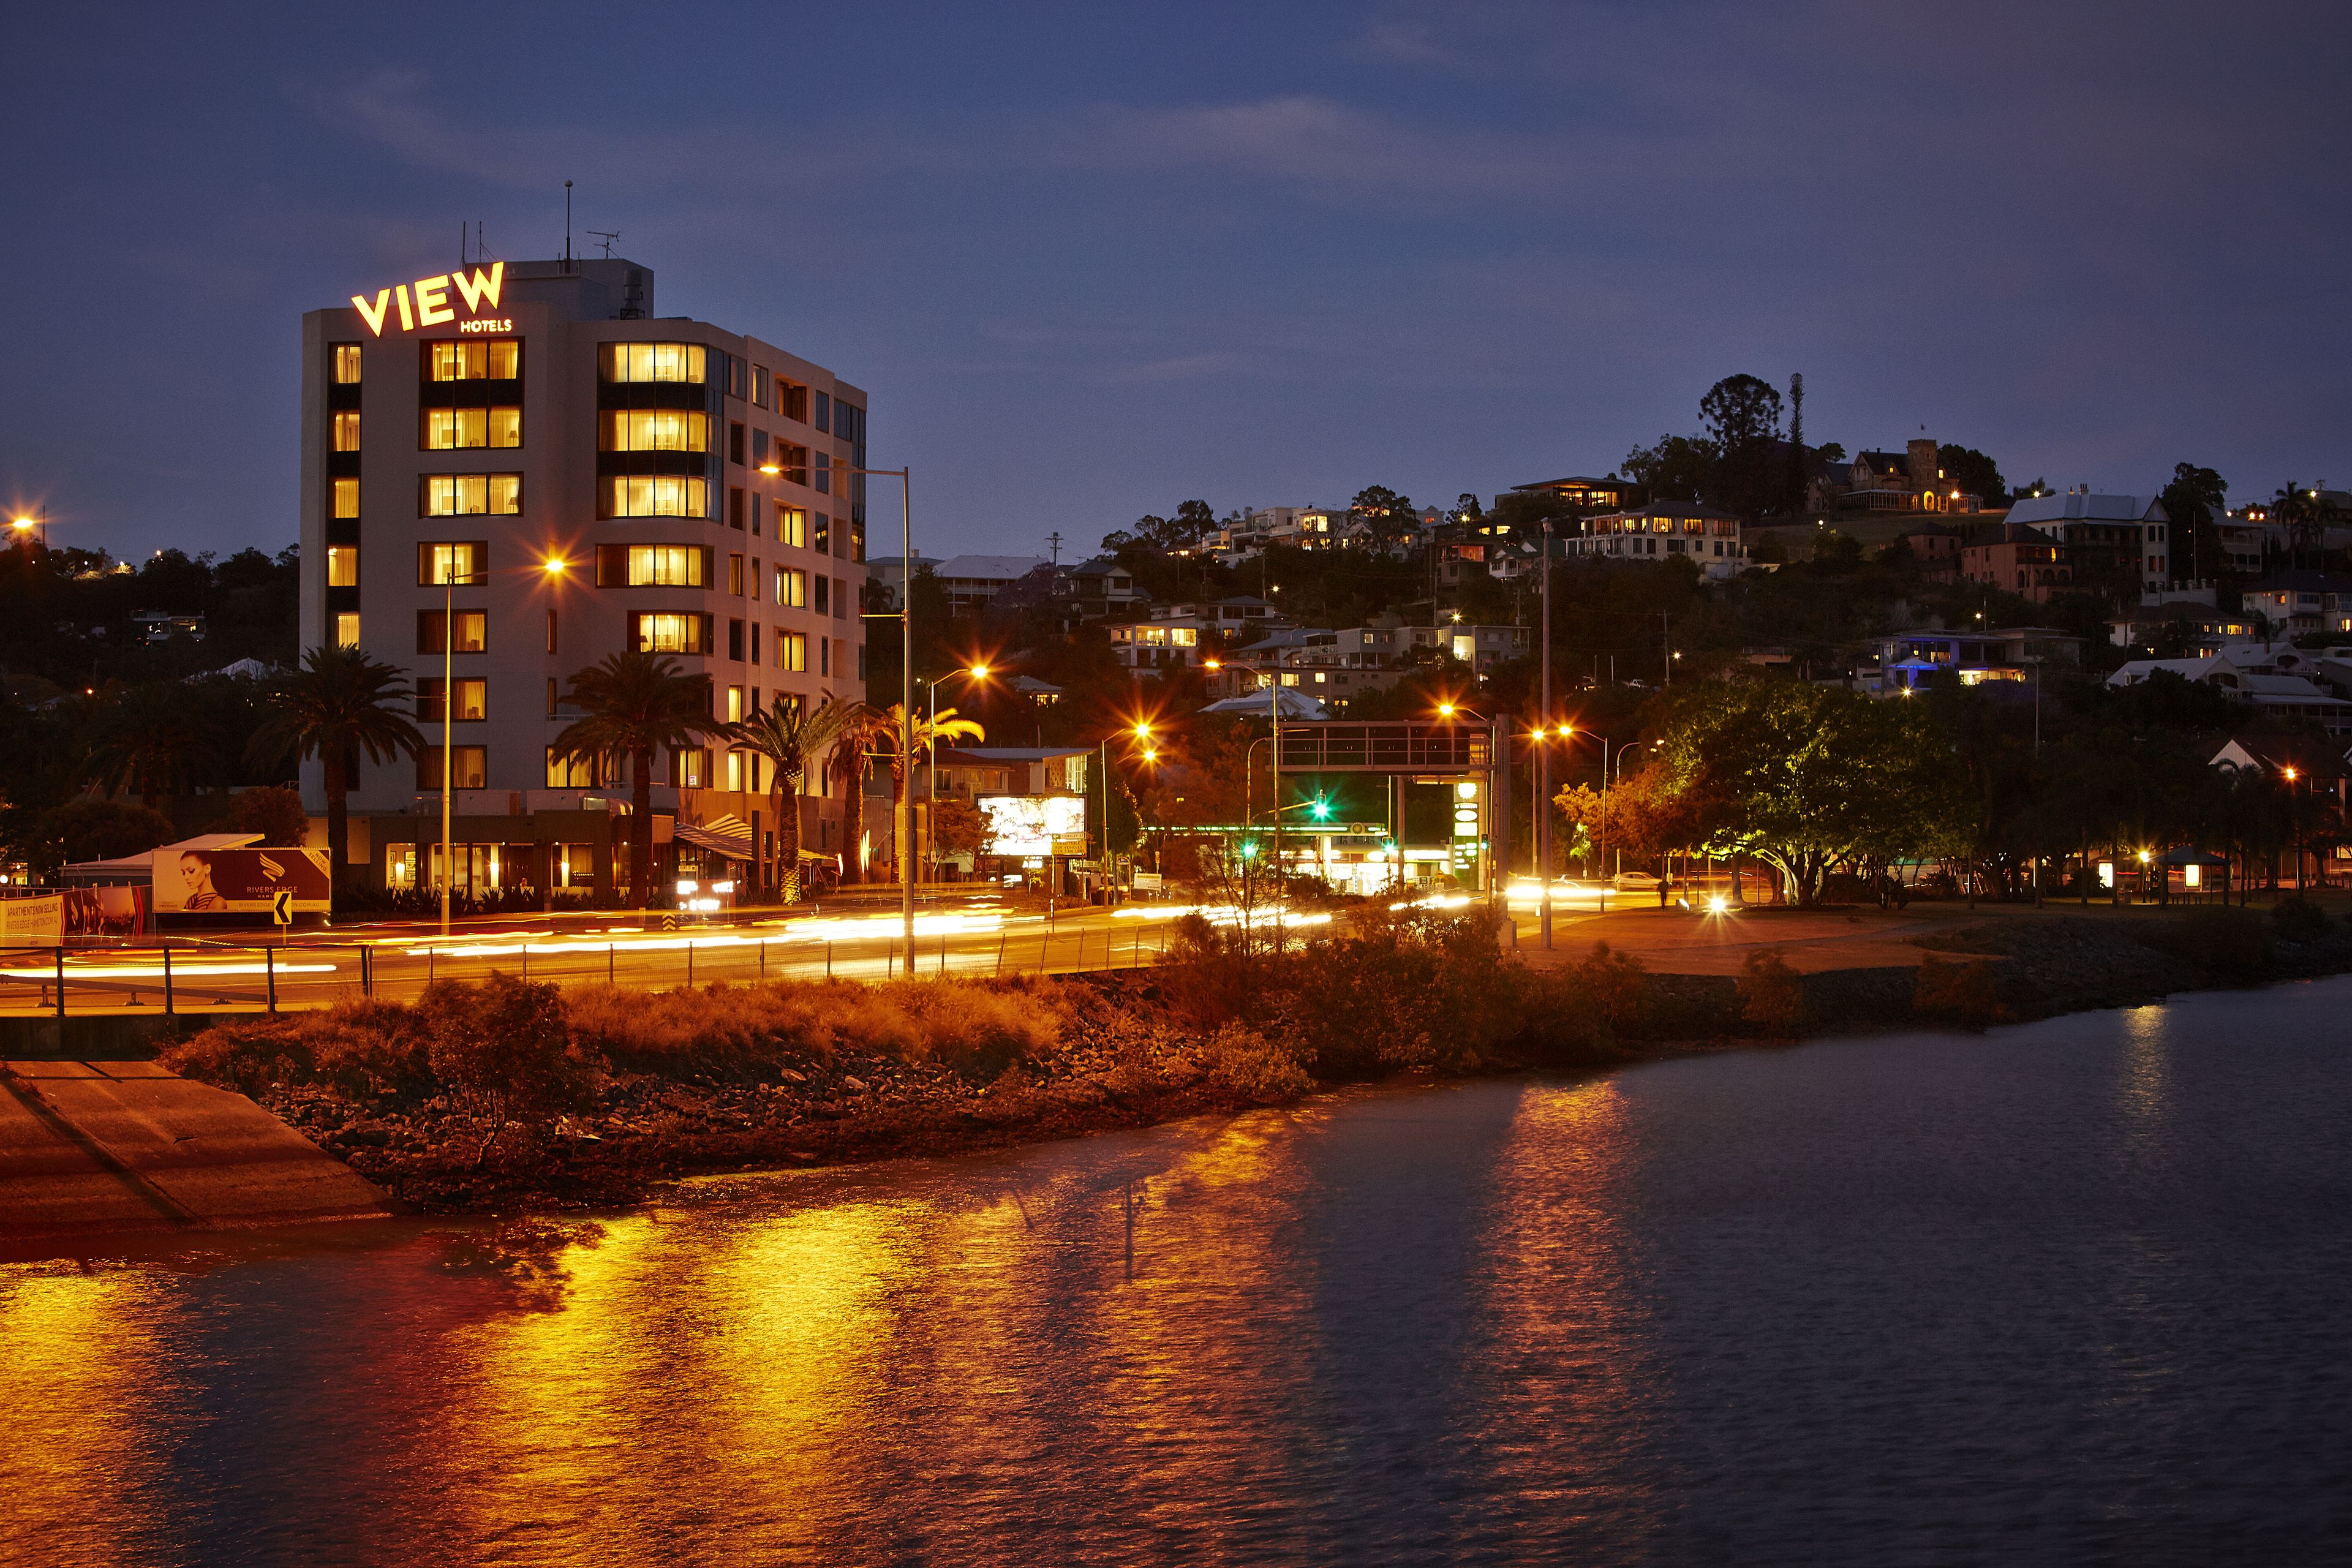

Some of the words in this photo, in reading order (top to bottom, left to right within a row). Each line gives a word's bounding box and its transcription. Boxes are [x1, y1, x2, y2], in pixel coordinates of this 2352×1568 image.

[350, 261, 505, 338] VIEW
[460, 319, 512, 333] HOTELS
[308, 852, 327, 872] SELLING
[315, 853, 326, 864] NOW
[7, 906, 35, 917] APARTMENTS
[44, 902, 58, 913] SELLING
[20, 919, 29, 929] EDGE
